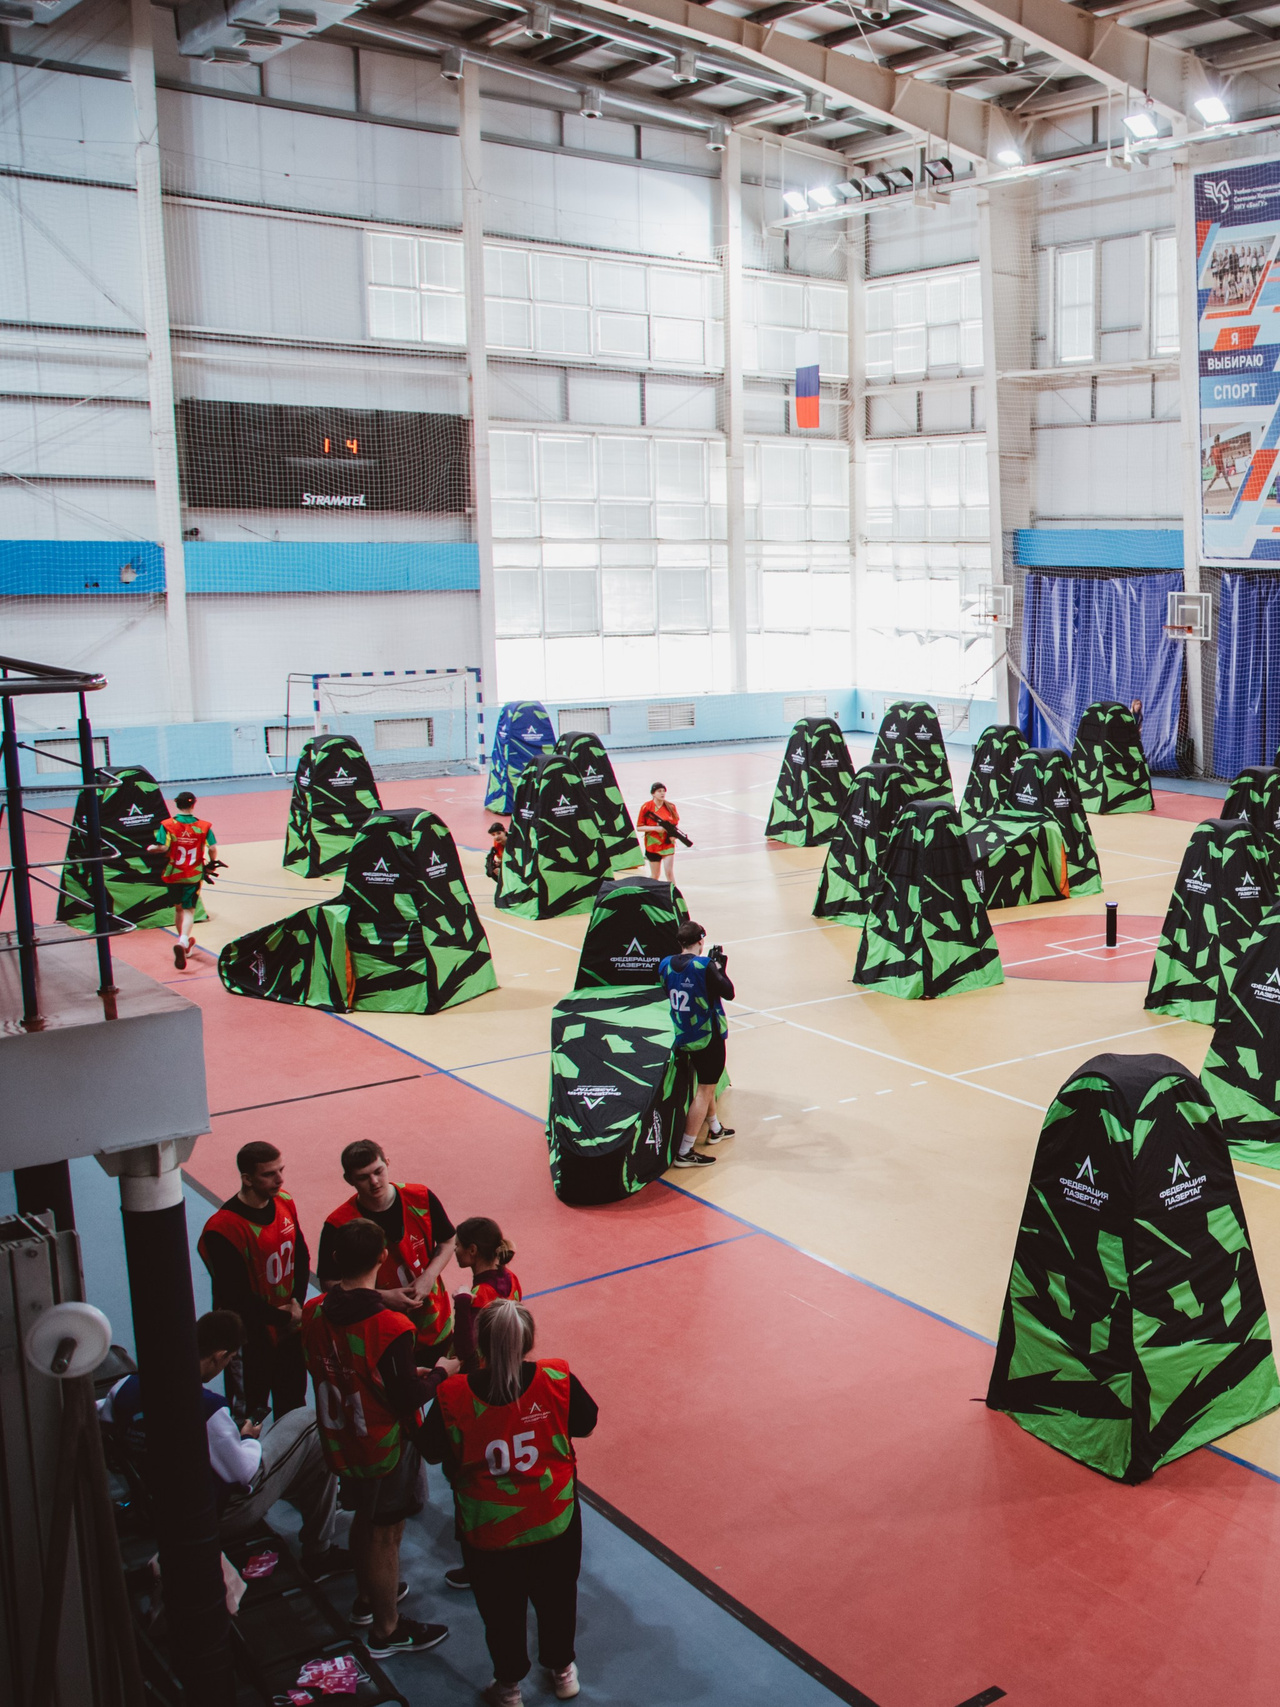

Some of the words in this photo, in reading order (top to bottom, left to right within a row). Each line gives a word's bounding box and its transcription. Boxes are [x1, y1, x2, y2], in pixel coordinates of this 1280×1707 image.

[1231, 332, 1239, 345] Я
[1207, 354, 1264, 370] ВЫБИРАЮ
[1213, 383, 1258, 400] СПОРТ
[302, 492, 367, 507] STRAMATEL
[669, 988, 691, 1012] 02
[1059, 1177, 1109, 1200] ФЕДЕРАЦИЯ
[1063, 1187, 1103, 1207] ЛАЗЕРТАГ
[1159, 1175, 1207, 1199] ФЕДЕРАЦИЯ
[1165, 1185, 1202, 1207] ЛАЗЕРТАГ
[266, 1240, 294, 1285] 02
[318, 1380, 368, 1436] 01
[485, 1430, 539, 1476] 05
